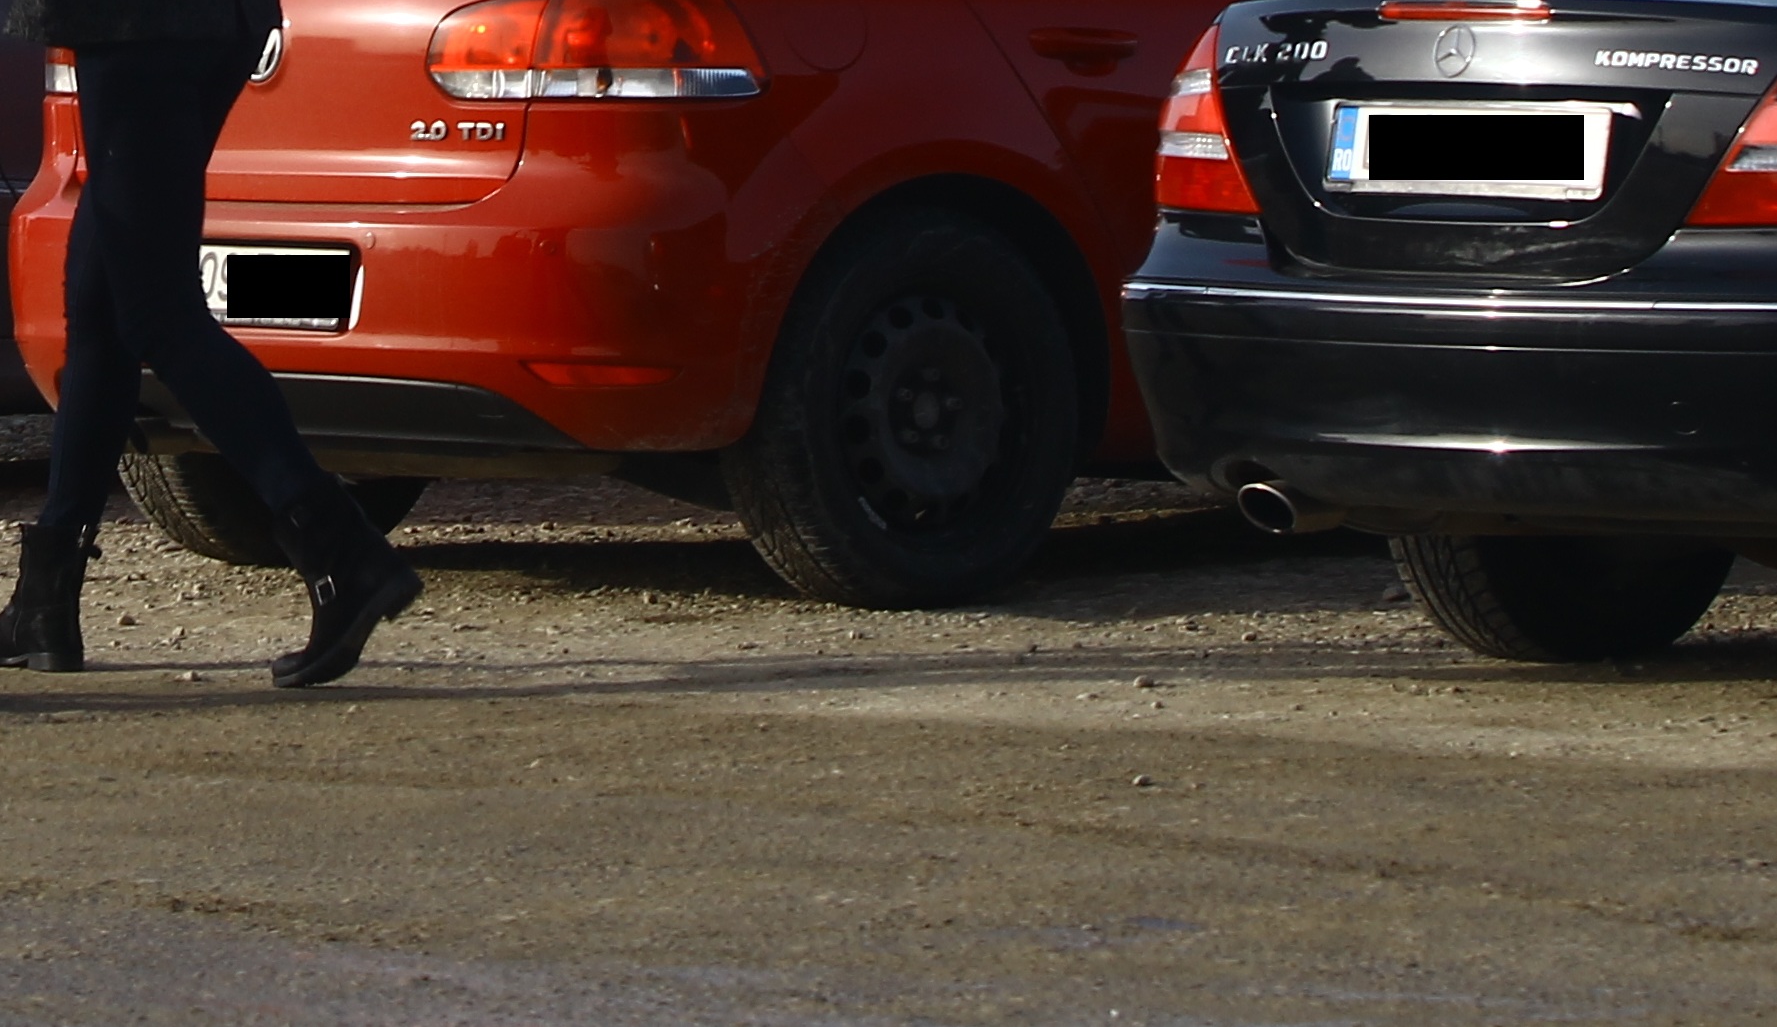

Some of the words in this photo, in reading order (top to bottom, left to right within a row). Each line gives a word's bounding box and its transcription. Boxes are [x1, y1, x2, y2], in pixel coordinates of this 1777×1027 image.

[1225, 42, 1270, 64] CLK
[1277, 40, 1329, 62] 200
[1594, 49, 1760, 75] KOMPRESSOR
[456, 121, 506, 141] TDI
[1331, 148, 1353, 172] RO
